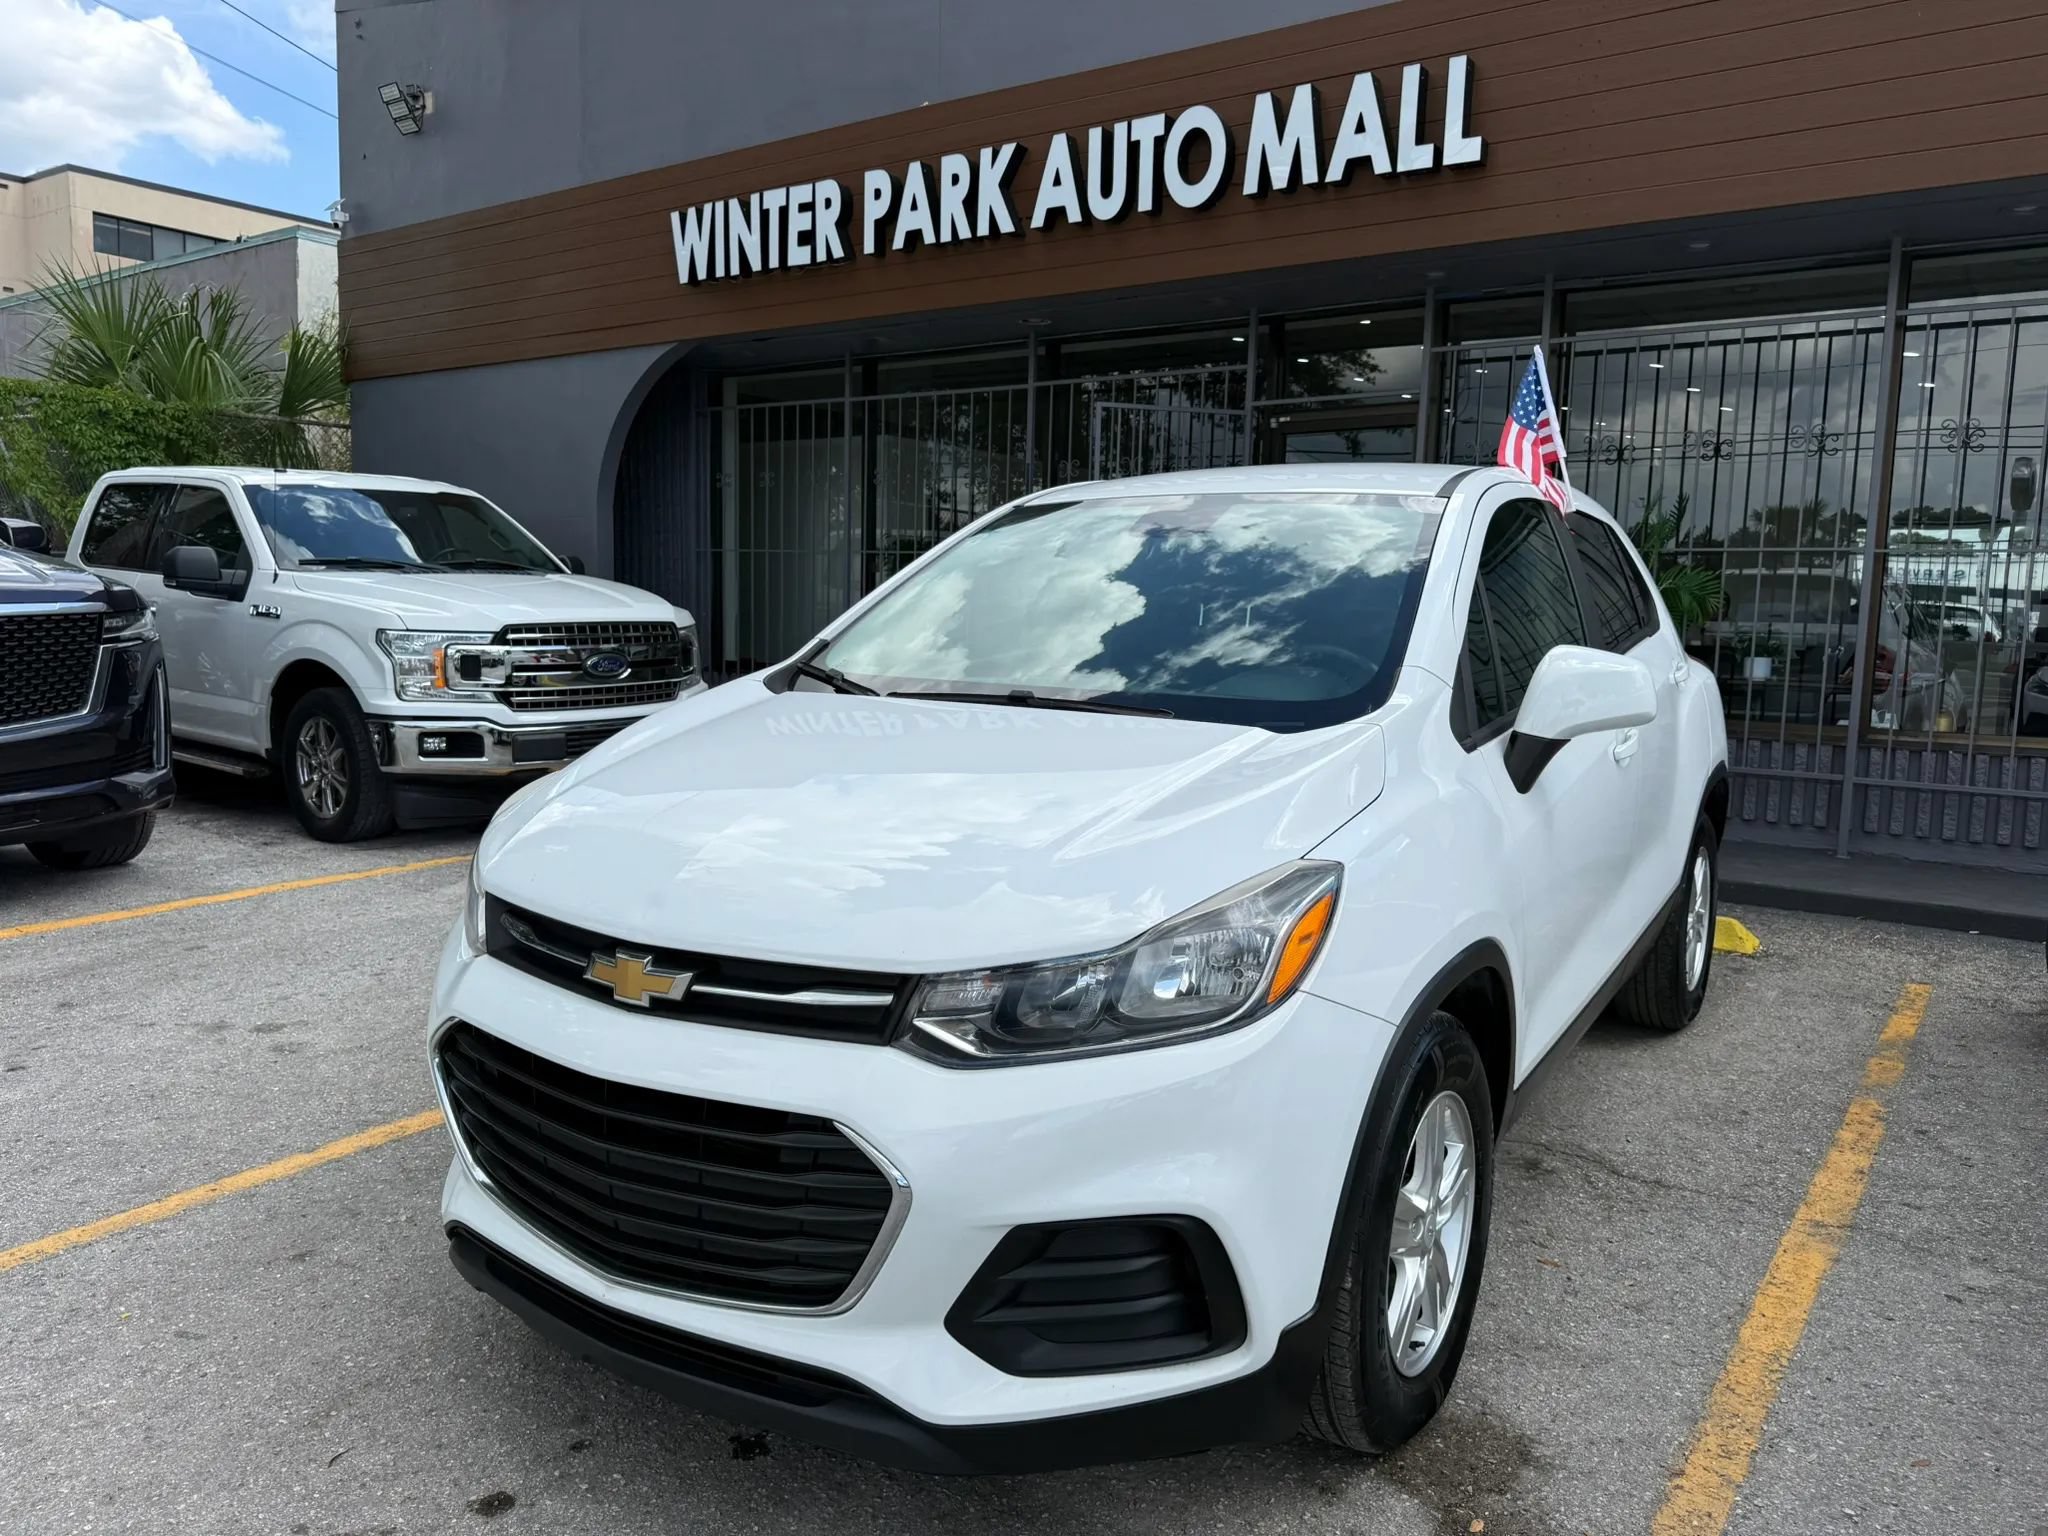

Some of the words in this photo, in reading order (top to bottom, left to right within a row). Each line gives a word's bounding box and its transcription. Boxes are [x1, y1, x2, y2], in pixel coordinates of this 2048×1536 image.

[671, 180, 844, 283] WINTER
[864, 143, 1018, 254] PARK
[1031, 106, 1225, 228] AUTO
[1243, 55, 1481, 194] MALL
